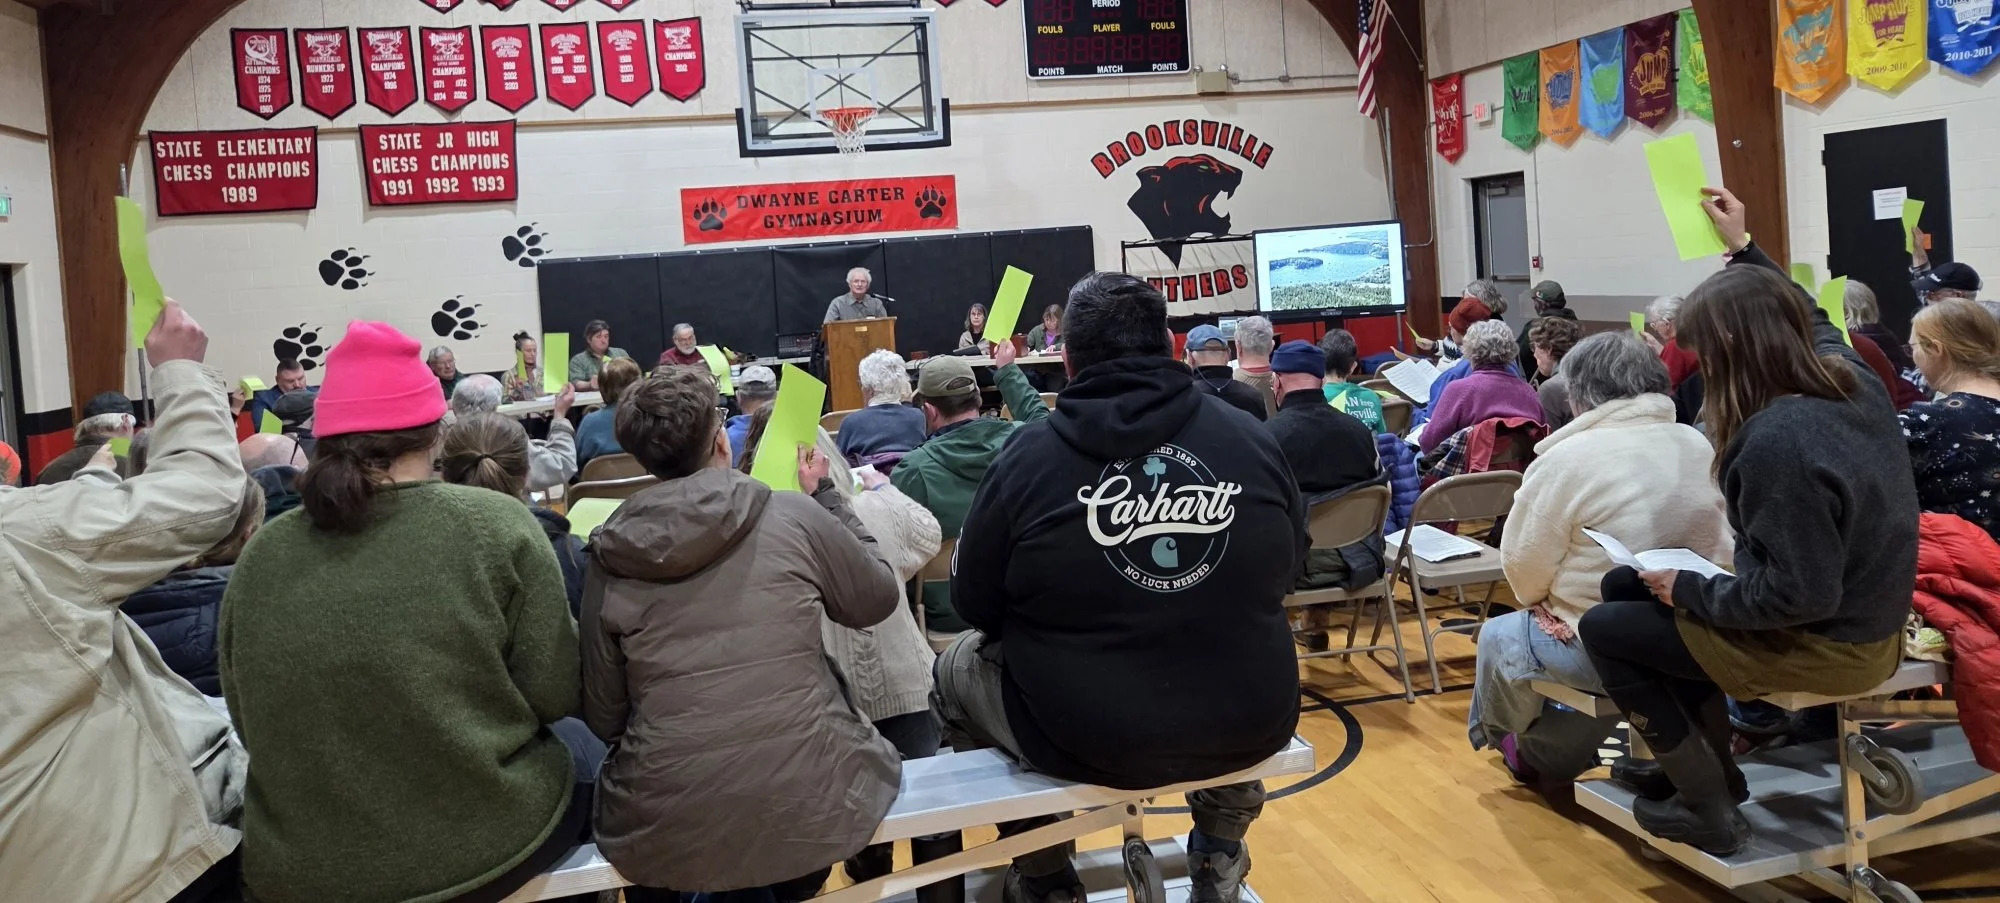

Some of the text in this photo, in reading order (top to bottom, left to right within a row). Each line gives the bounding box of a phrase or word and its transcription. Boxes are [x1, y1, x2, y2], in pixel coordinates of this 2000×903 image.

[1038, 22, 1176, 34] FOULS PLAYER FOULS
[1888, 25, 1904, 34] HEART
[664, 52, 696, 60] CHAMPIONS
[1944, 46, 1992, 61] 2010-2011
[244, 66, 280, 74] CHAMPIONS
[306, 64, 345, 73] RUNNERS UP
[371, 62, 405, 71] CHAMPIONS
[432, 67, 466, 76] CHAMPIONS
[1038, 63, 1178, 76] POINTS MATCH POINTS
[156, 137, 312, 158] STATE ELEMENTARY
[379, 130, 499, 150] STATE JR HIGH
[1091, 119, 1274, 179] BROOKSVILLE
[163, 161, 310, 181] CHESS CHAMPIONS
[372, 153, 509, 174] CHESS CHAMPIONS
[382, 175, 505, 196] 1991 1992 1993
[222, 186, 257, 203] 1989
[737, 187, 904, 208] DWAYNE CARTER
[763, 209, 882, 229] GYMNASIUM
[1348, 408, 1378, 419] ksville
[1176, 450, 1197, 467] 1889
[1077, 475, 1242, 546] Carhartt
[1124, 563, 1210, 589] NO LUCK NEEDED
